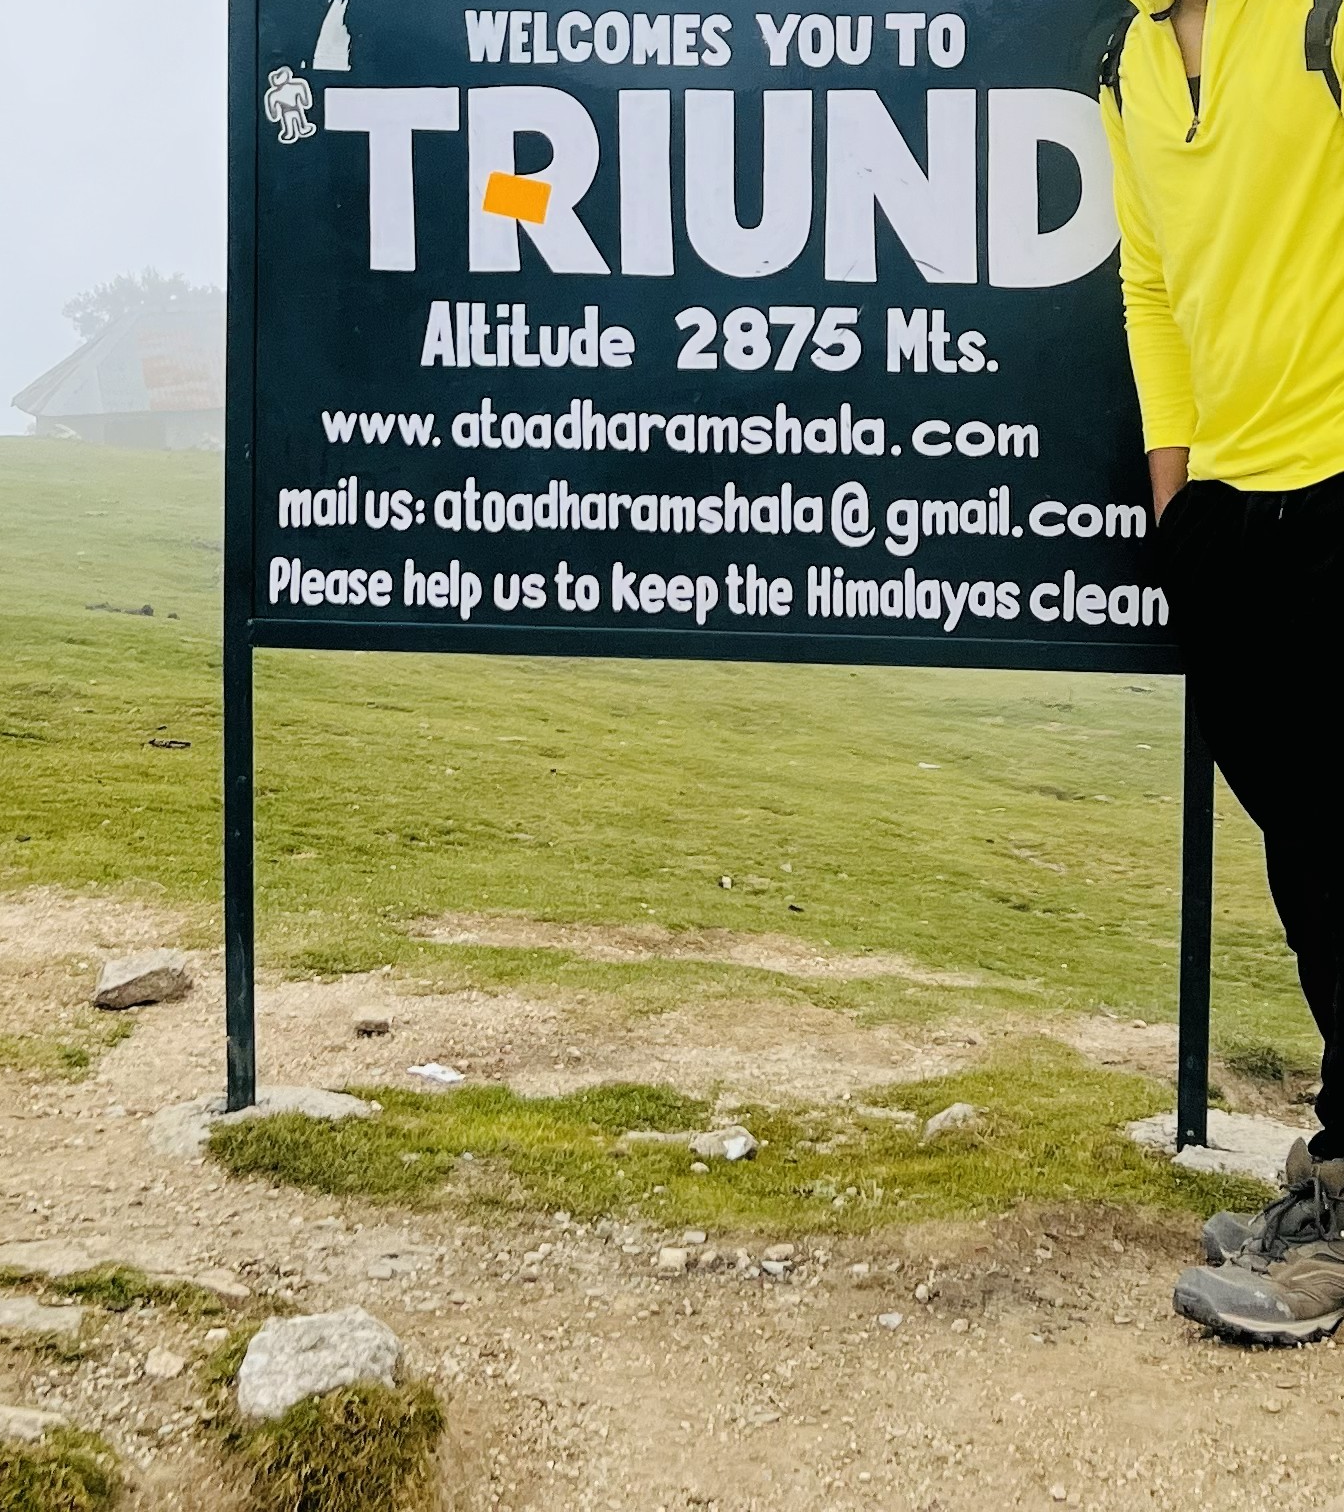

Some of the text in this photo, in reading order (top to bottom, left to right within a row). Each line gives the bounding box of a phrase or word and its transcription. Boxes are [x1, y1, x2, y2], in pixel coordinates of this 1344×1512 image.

[464, 9, 966, 69] WELCOMES YOU TO
[324, 85, 1122, 288] TRIUND
[420, 300, 999, 373] Altitude 2875 Mts.
[269, 556, 1169, 632] Please help us to keep the Himalayas clean
